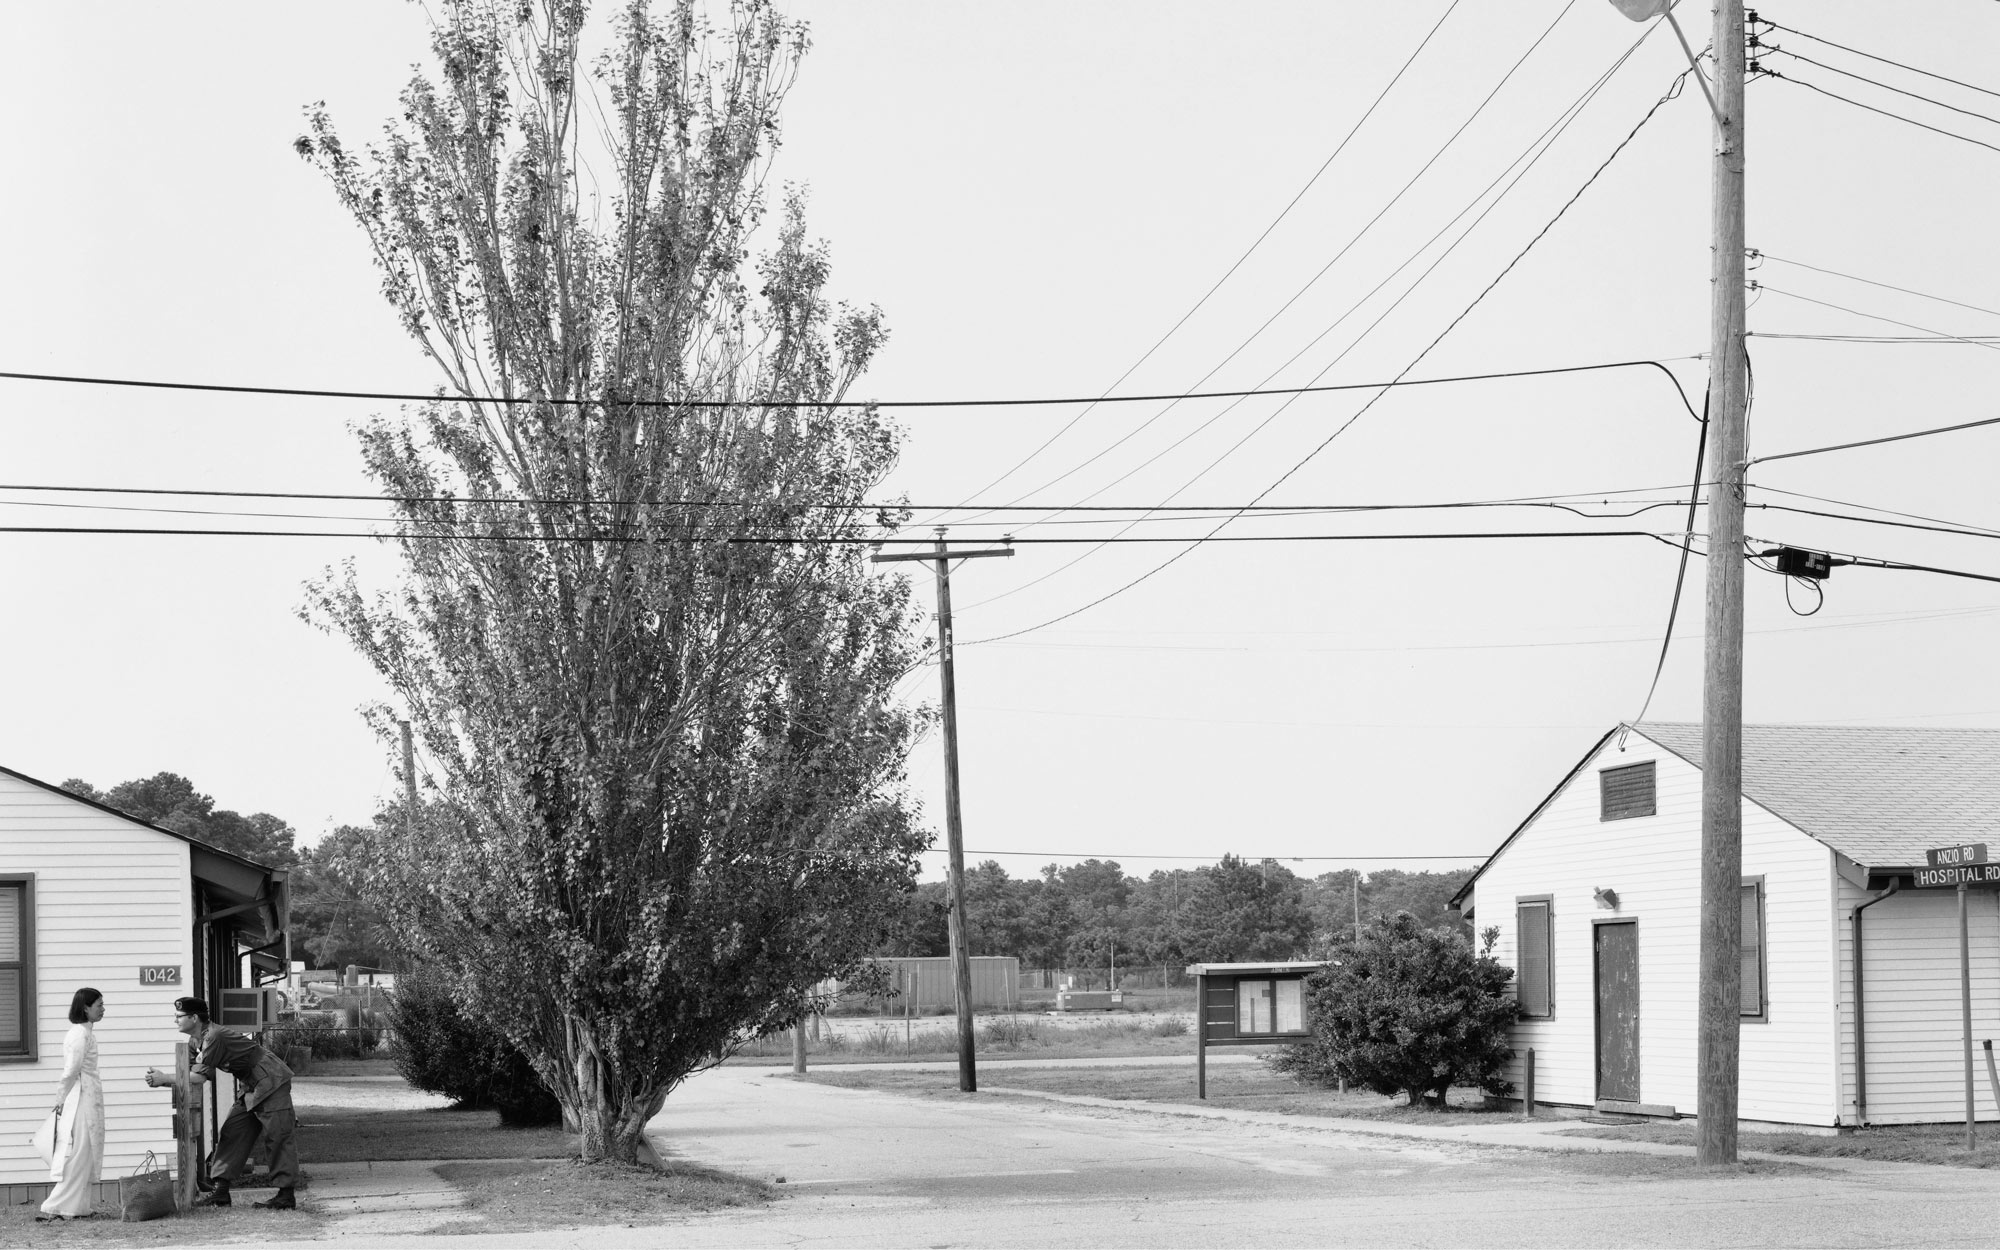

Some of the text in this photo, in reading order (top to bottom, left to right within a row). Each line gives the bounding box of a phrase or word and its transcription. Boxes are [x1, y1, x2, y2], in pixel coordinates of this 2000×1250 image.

[1937, 847, 1974, 865] ANZIO RD
[1920, 866, 2000, 885] HOSPITAL RD
[144, 968, 175, 982] 1042
